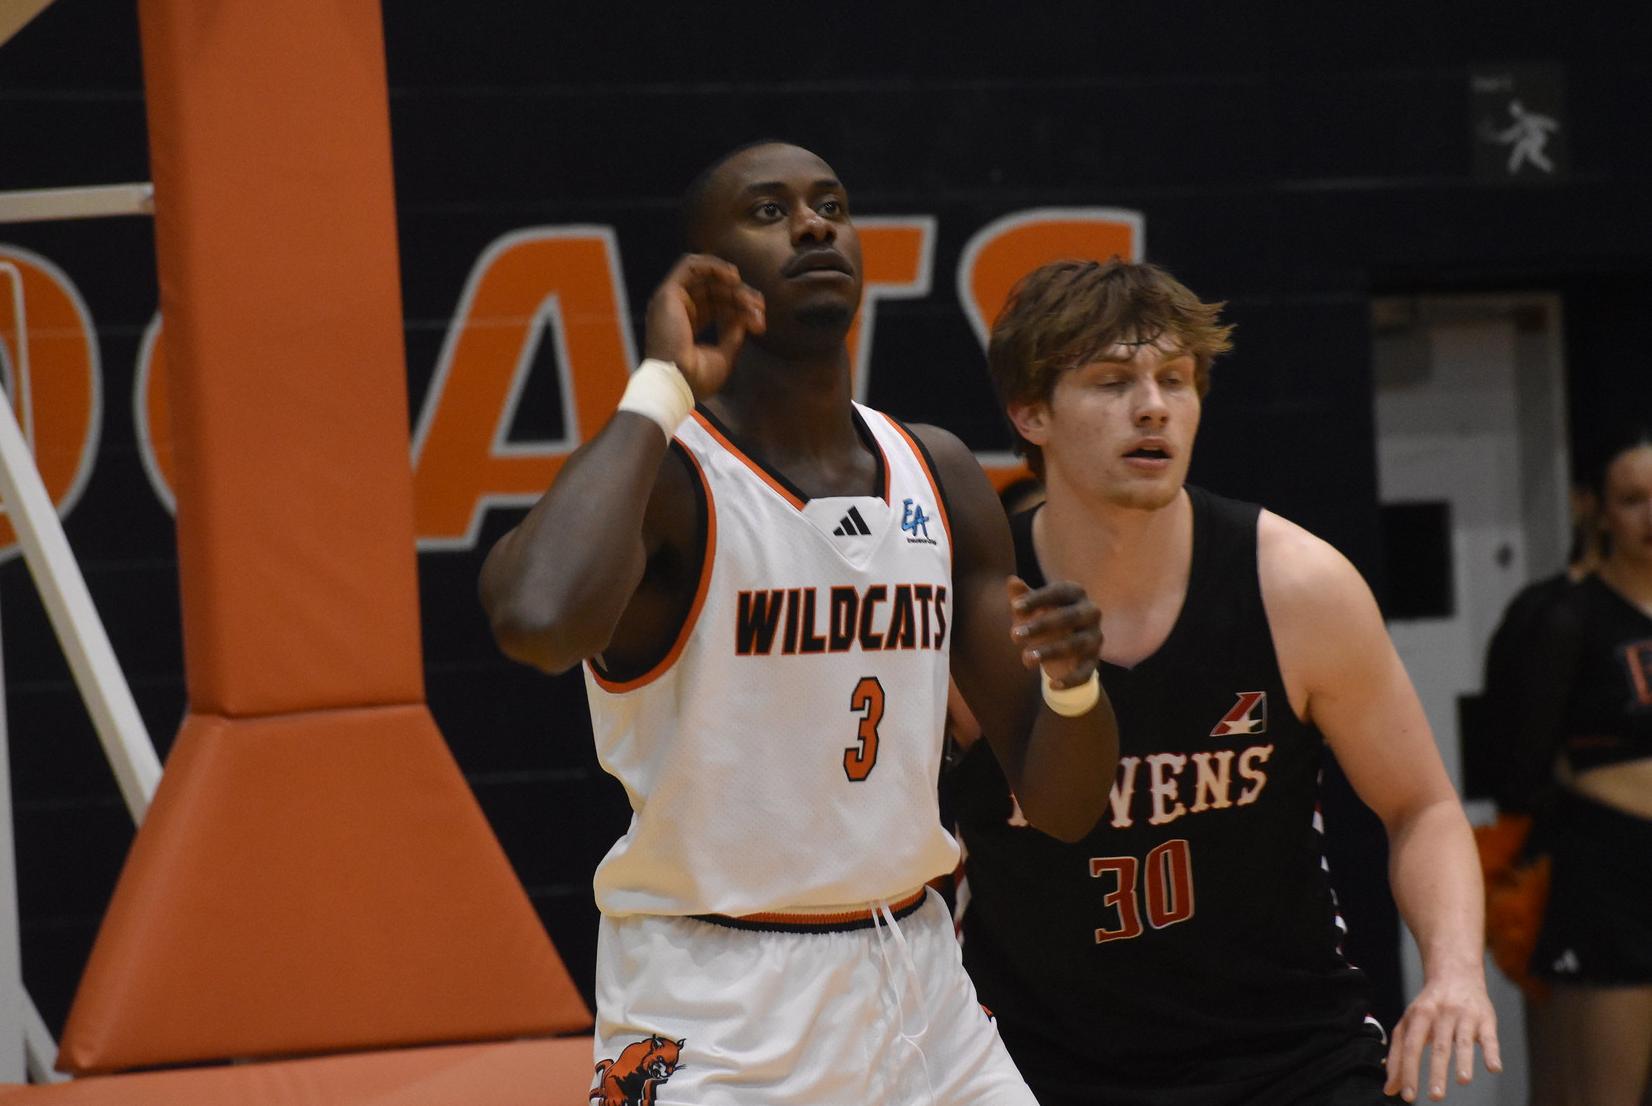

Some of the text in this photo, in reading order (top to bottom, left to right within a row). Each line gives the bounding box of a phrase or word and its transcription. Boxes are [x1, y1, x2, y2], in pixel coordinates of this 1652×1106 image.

[735, 584, 947, 655] WILDCATS
[843, 676, 886, 782] 3
[1007, 744, 1274, 828] VENS
[1088, 839, 1196, 944] 30
